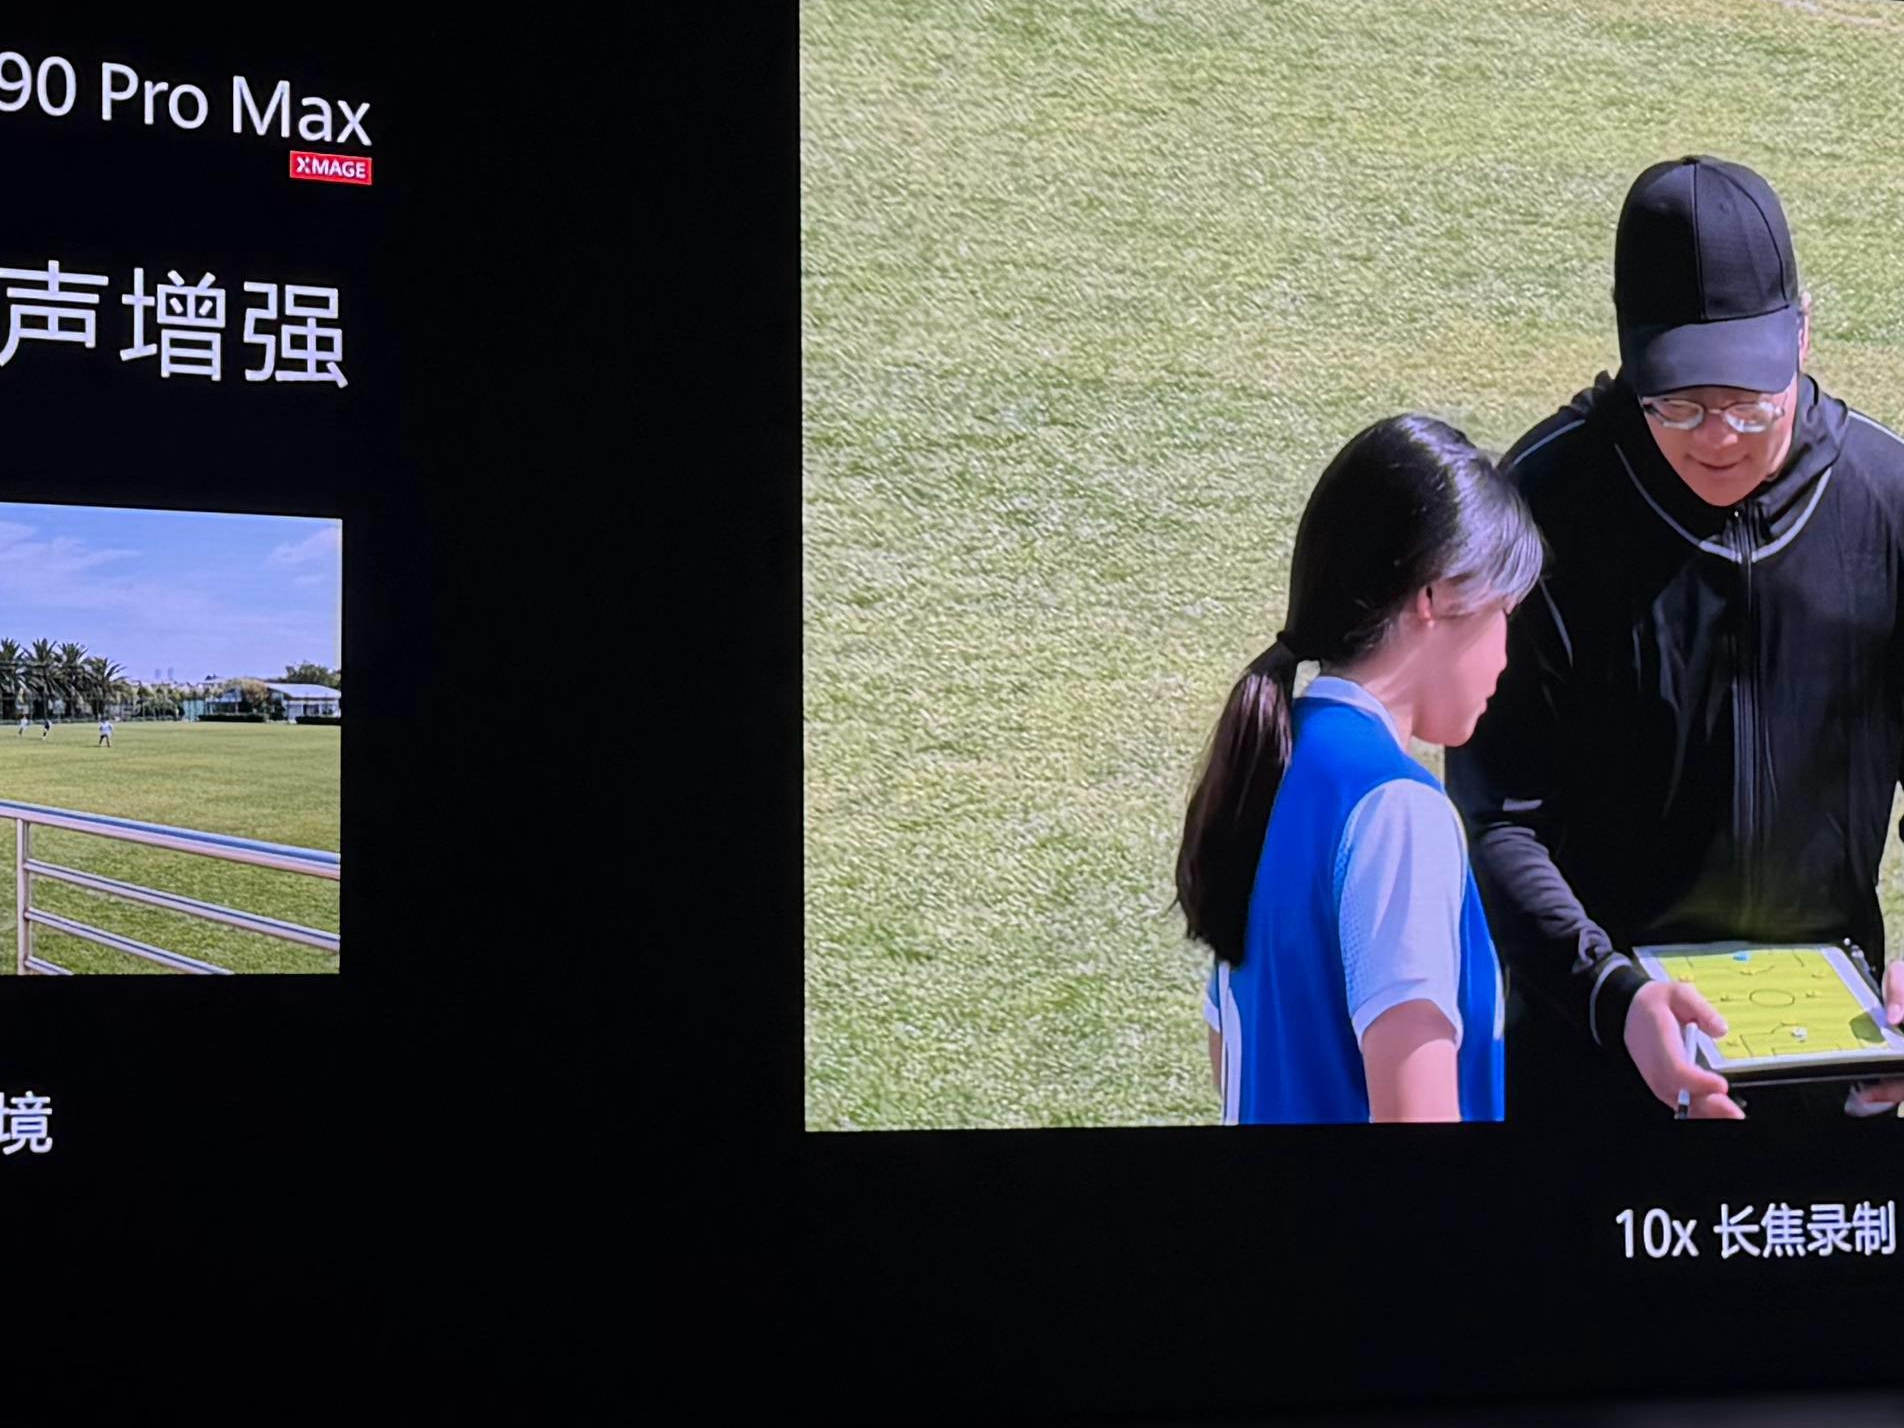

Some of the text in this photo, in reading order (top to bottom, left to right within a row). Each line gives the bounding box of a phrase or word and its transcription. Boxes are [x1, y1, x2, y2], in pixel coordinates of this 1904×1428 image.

[101, 61, 209, 130] Pro
[232, 75, 373, 147] Max
[295, 155, 366, 179] XMAGE
[1615, 1199, 1897, 1260] 10x 长焦录制
